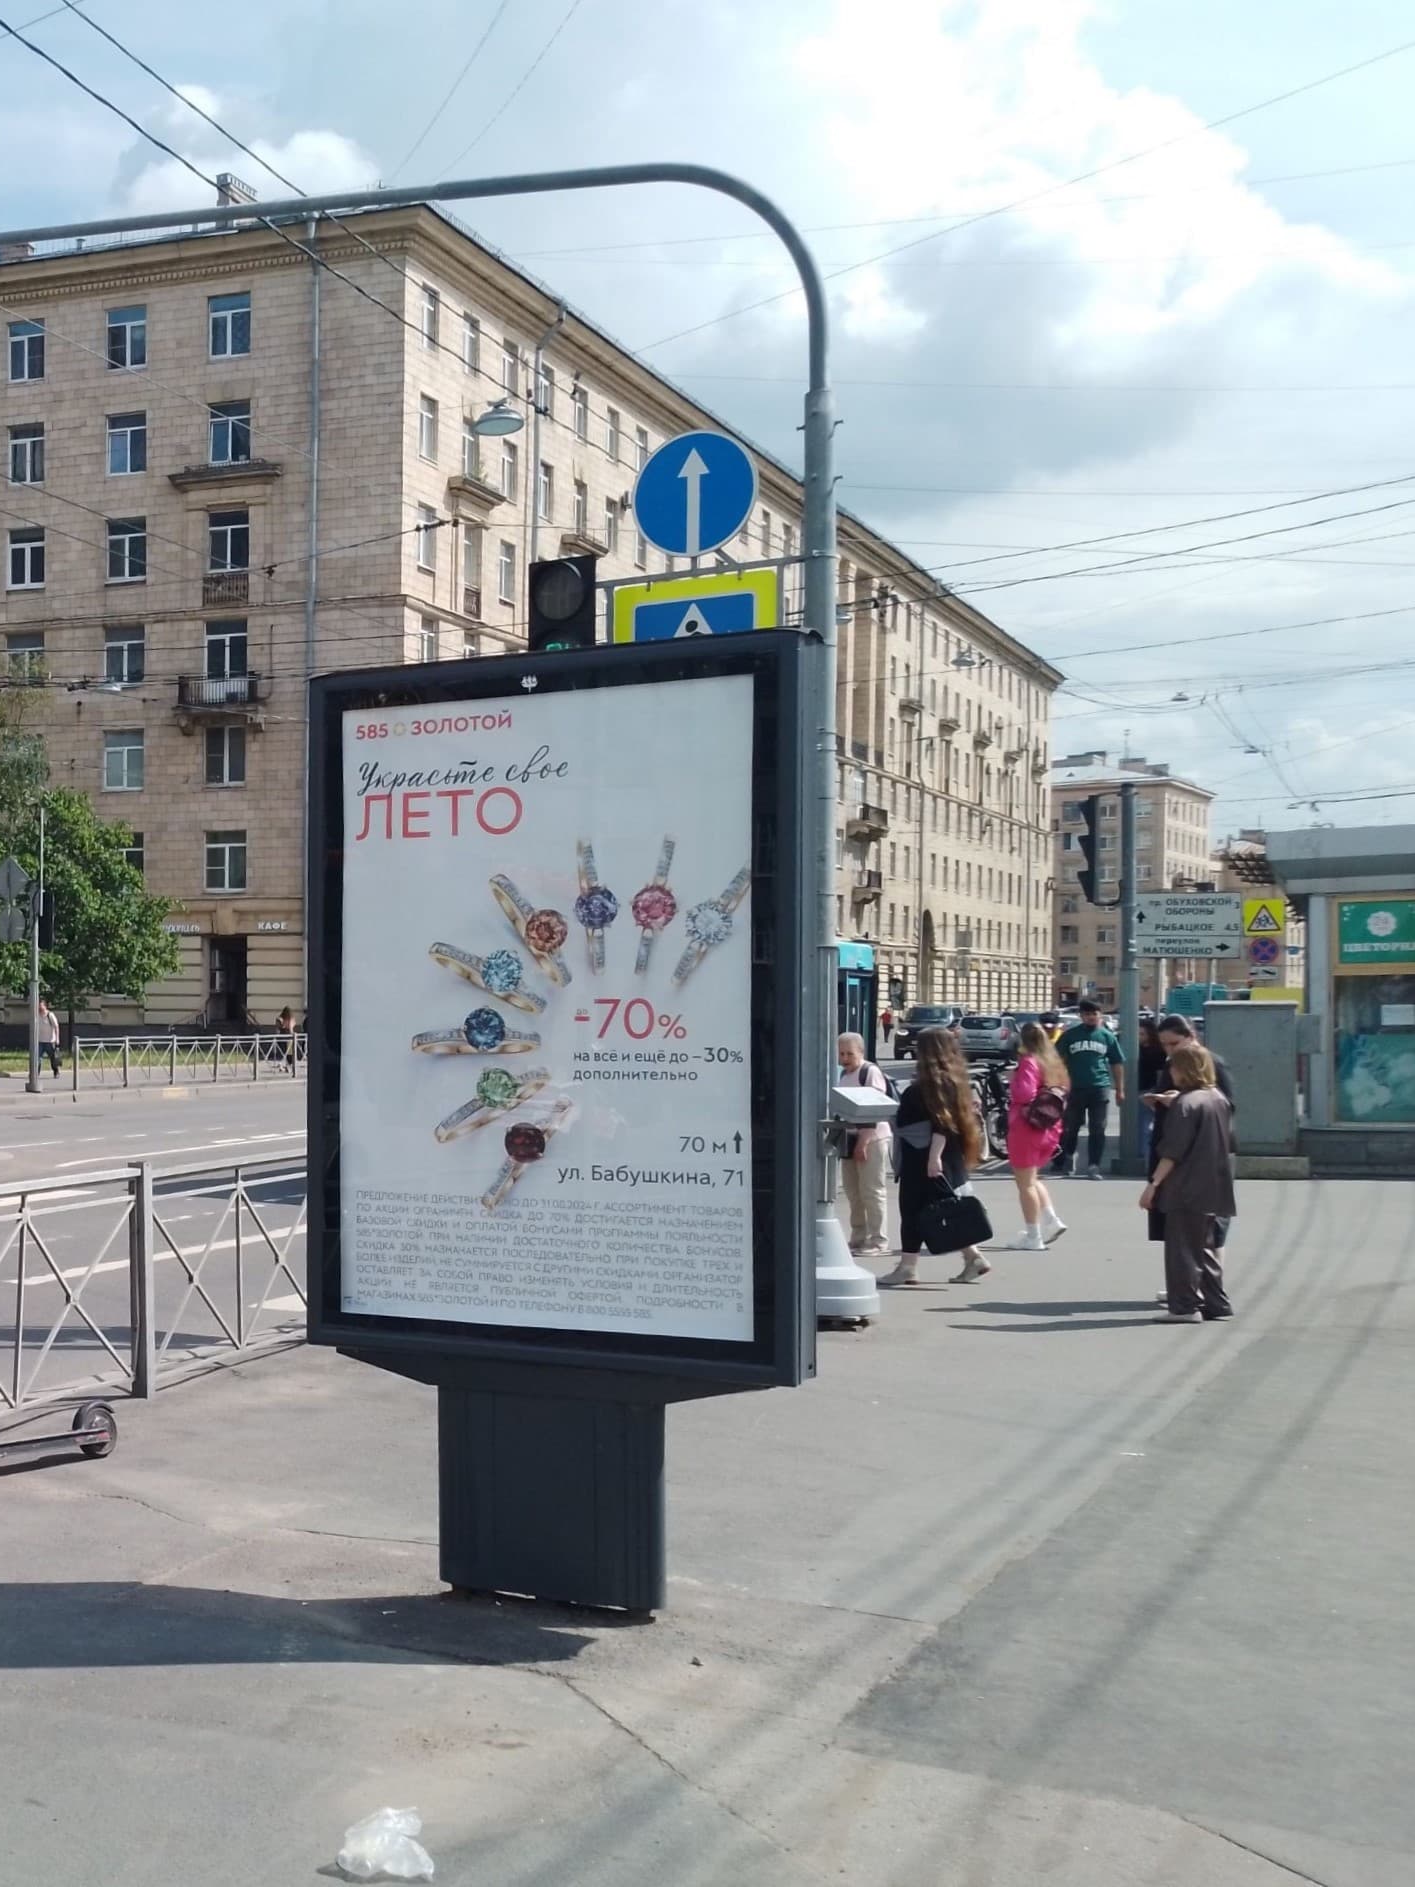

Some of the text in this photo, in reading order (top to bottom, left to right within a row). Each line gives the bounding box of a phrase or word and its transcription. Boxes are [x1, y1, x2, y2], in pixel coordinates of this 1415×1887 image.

[356, 709, 512, 740] 585 ЗОЛОТОЙ
[356, 745, 569, 796] Украсьте свое
[356, 786, 523, 841] ЛЕТО
[258, 921, 289, 931] КАФЕ
[1155, 923, 1215, 931] РЫБАЦКОЕ
[573, 1052, 590, 1062] на
[593, 1049, 619, 1062] всё
[621, 1052, 631, 1062] и
[634, 1049, 666, 1064] ещё
[669, 1052, 688, 1064] до
[573, 1070, 698, 1081] дополнительно
[679, 1136, 727, 1154] 70 м
[557, 1165, 744, 1188] ул. Бабушкина, 71
